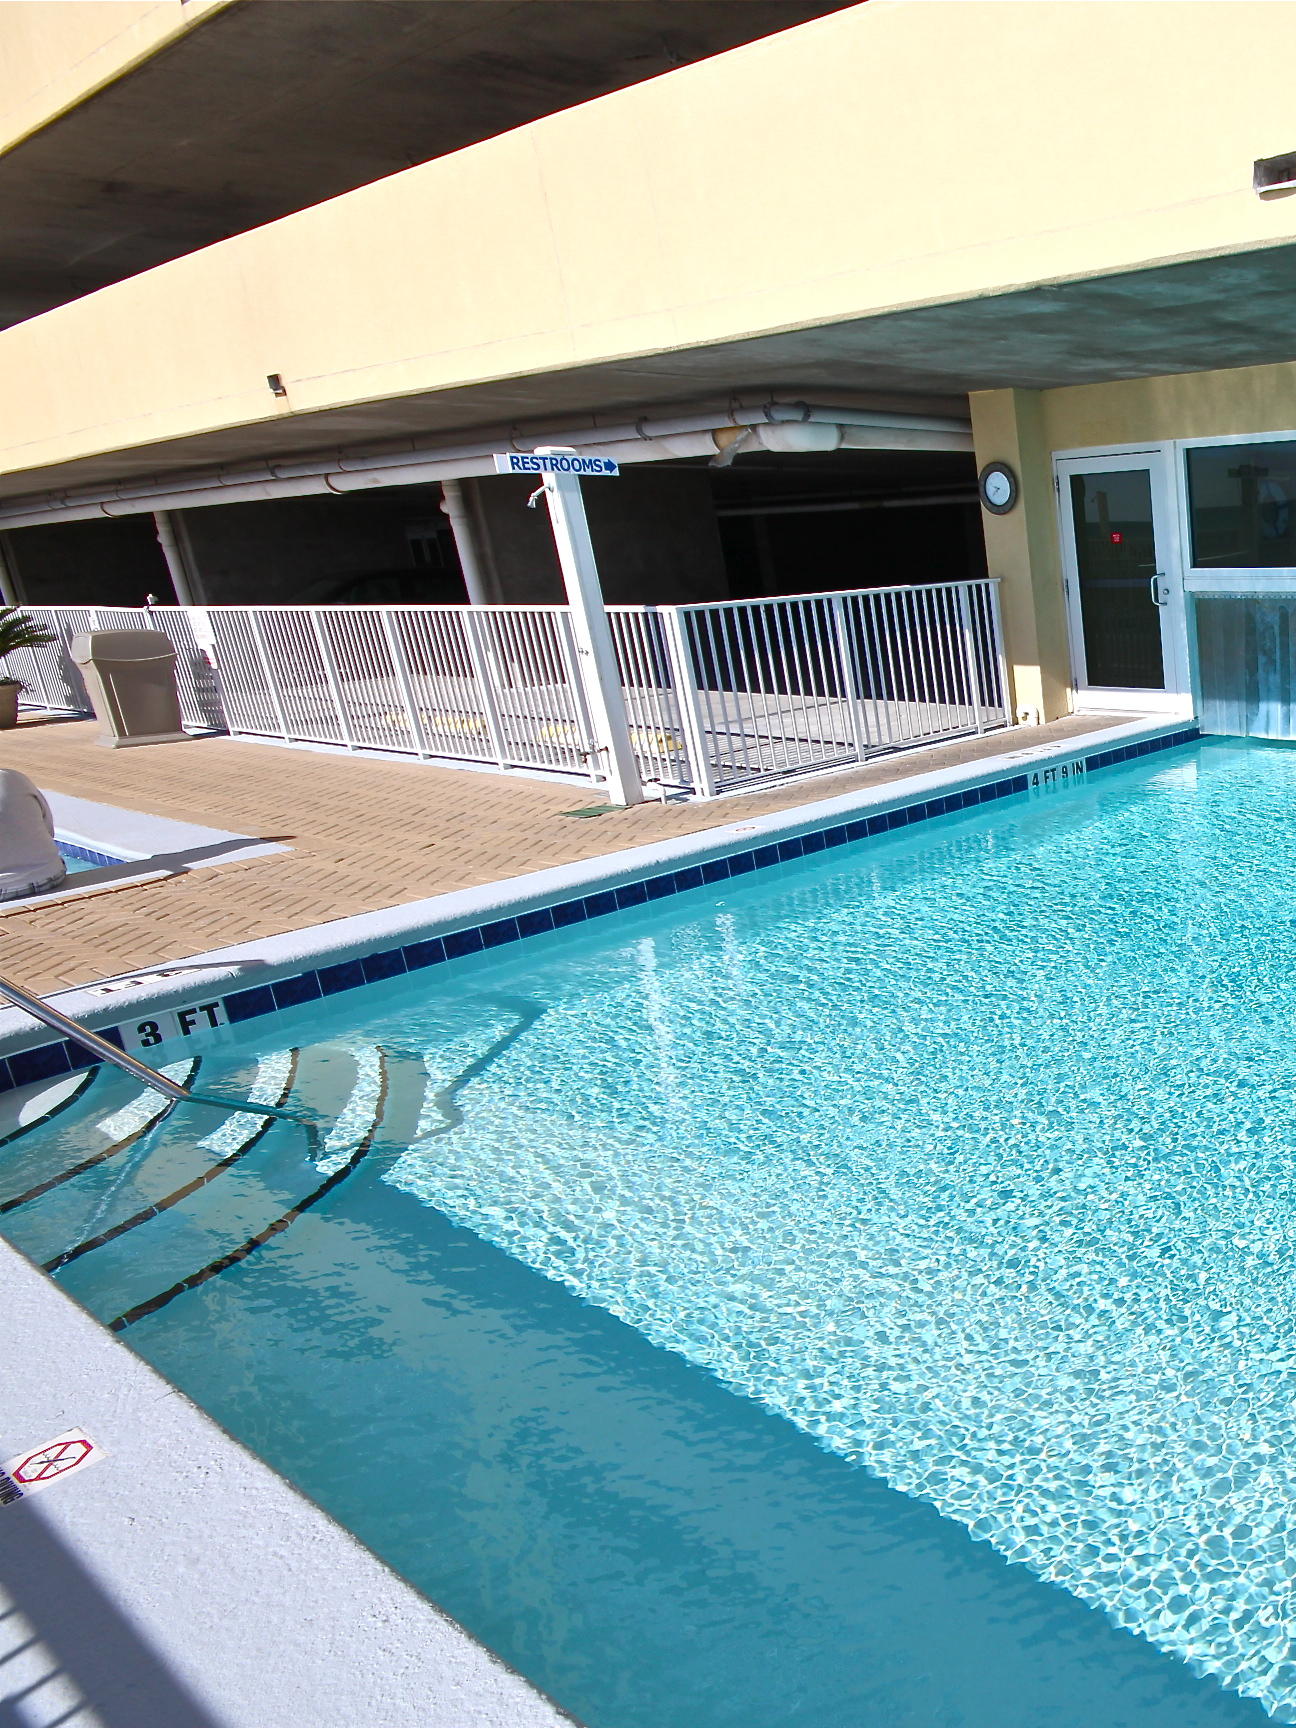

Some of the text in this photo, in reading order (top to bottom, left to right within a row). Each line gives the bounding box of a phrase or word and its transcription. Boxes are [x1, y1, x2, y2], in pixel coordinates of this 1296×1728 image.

[509, 455, 603, 473] RESTROOMS
[1031, 760, 1084, 787] 4 FT 9 IN
[137, 1020, 163, 1048] 3
